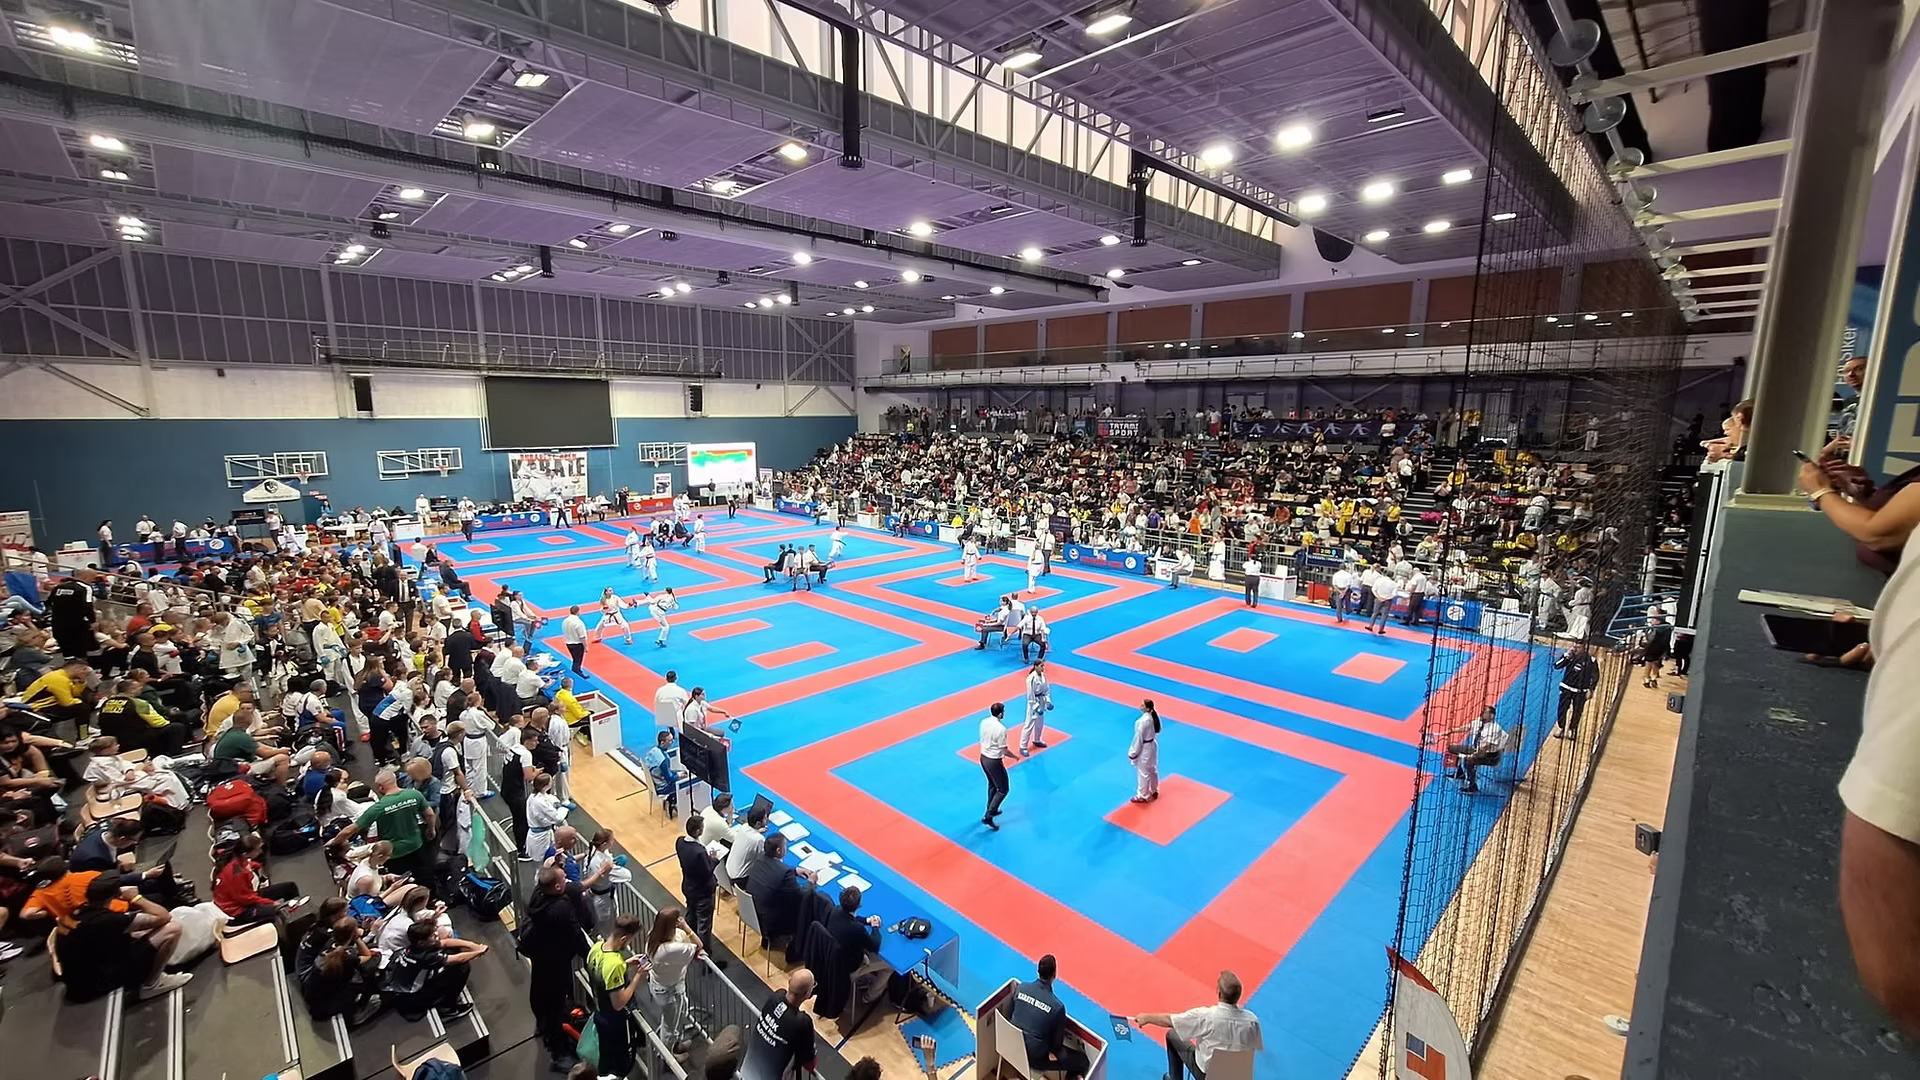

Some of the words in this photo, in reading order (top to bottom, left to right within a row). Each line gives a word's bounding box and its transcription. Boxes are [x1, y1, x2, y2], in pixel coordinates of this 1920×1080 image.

[511, 457, 585, 479] KRATE
[384, 798, 417, 811] BULGARIA
[1018, 992, 1035, 1006] KARATE
